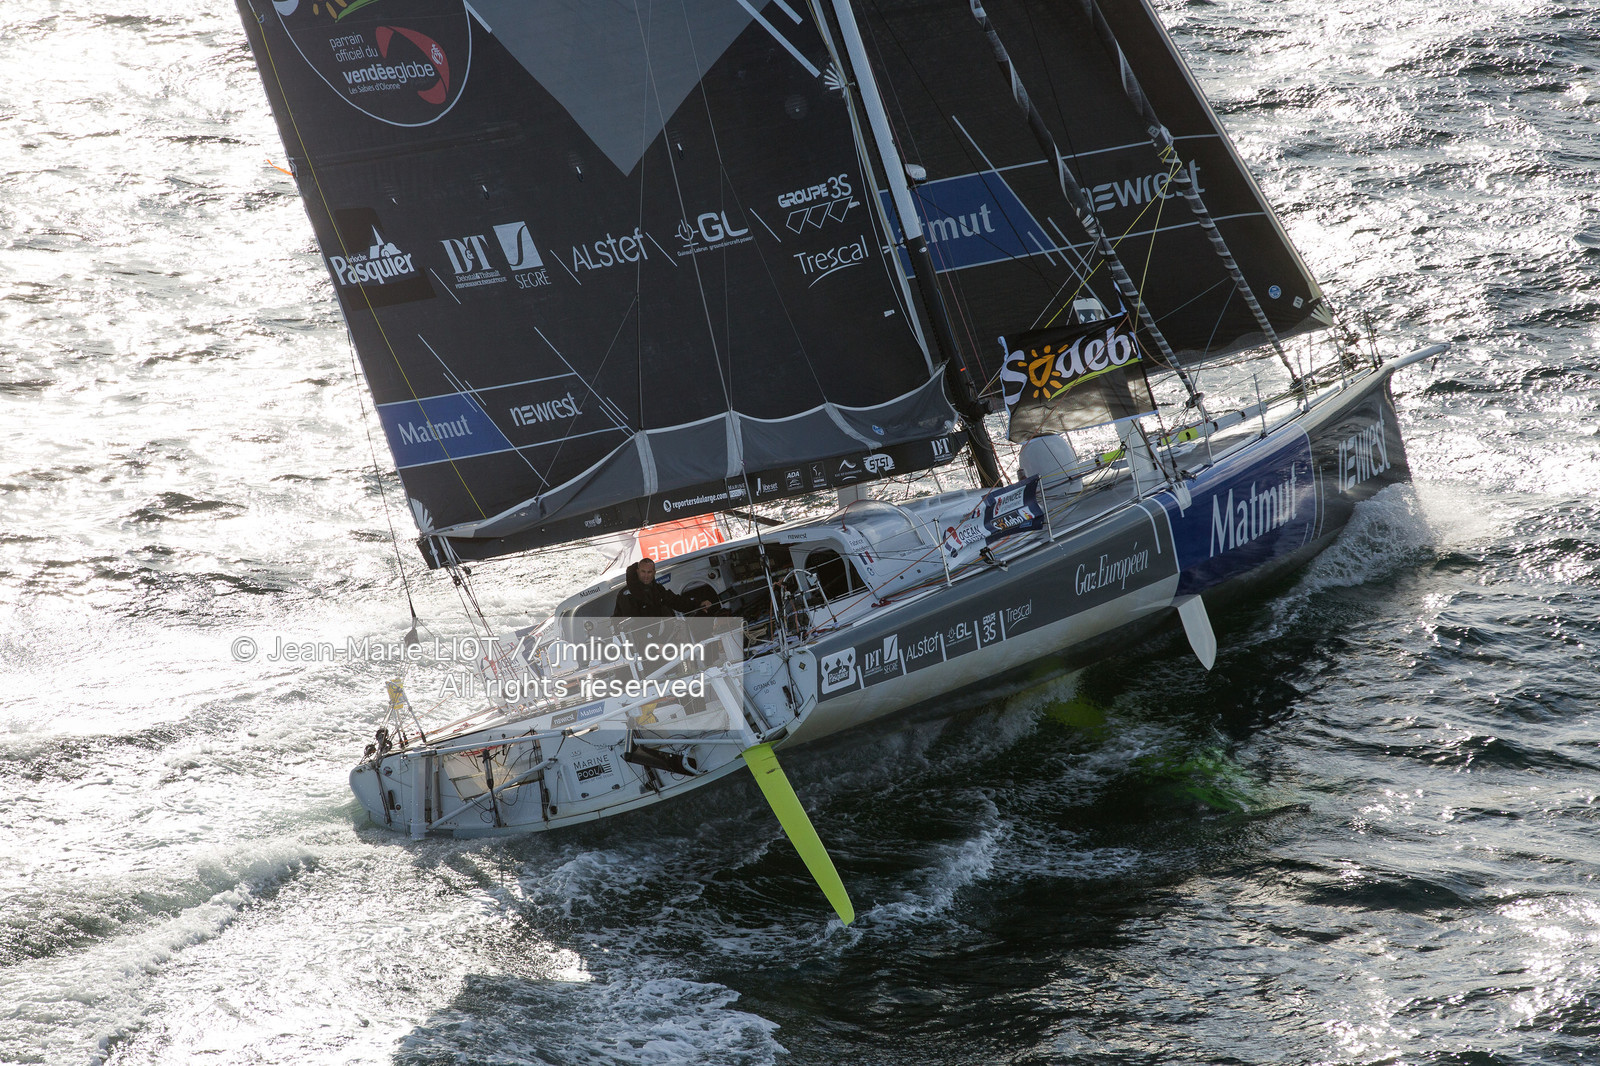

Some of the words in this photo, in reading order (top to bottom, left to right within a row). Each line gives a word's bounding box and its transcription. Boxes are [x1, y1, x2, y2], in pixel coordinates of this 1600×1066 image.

[329, 31, 364, 51] parrain
[335, 45, 365, 62] officiel
[365, 45, 379, 58] du
[777, 183, 828, 209] GROUPE
[827, 174, 852, 199] 3S
[1080, 159, 1205, 213] newret
[697, 210, 749, 242] GL
[793, 234, 869, 274] Trescal
[329, 253, 415, 286] Pasquier
[509, 391, 583, 427] newrest
[397, 414, 473, 446] Matmut
[1339, 404, 1391, 494] newrest
[787, 471, 800, 479] ADA
[672, 492, 728, 509] reportersdularge.com
[1210, 462, 1297, 558] Matmut
[959, 525, 982, 541] OCEAN
[1075, 563, 1097, 596] Gaz
[1097, 541, 1149, 590] Européen
[579, 587, 601, 598] Matmut
[982, 612, 997, 625] GROUPE
[1006, 599, 1032, 623] Trescal
[956, 622, 973, 639] GL
[983, 622, 997, 643] 3S
[580, 706, 602, 718] Matmut
[573, 754, 610, 770] MARINE
[577, 768, 600, 780] POOL
